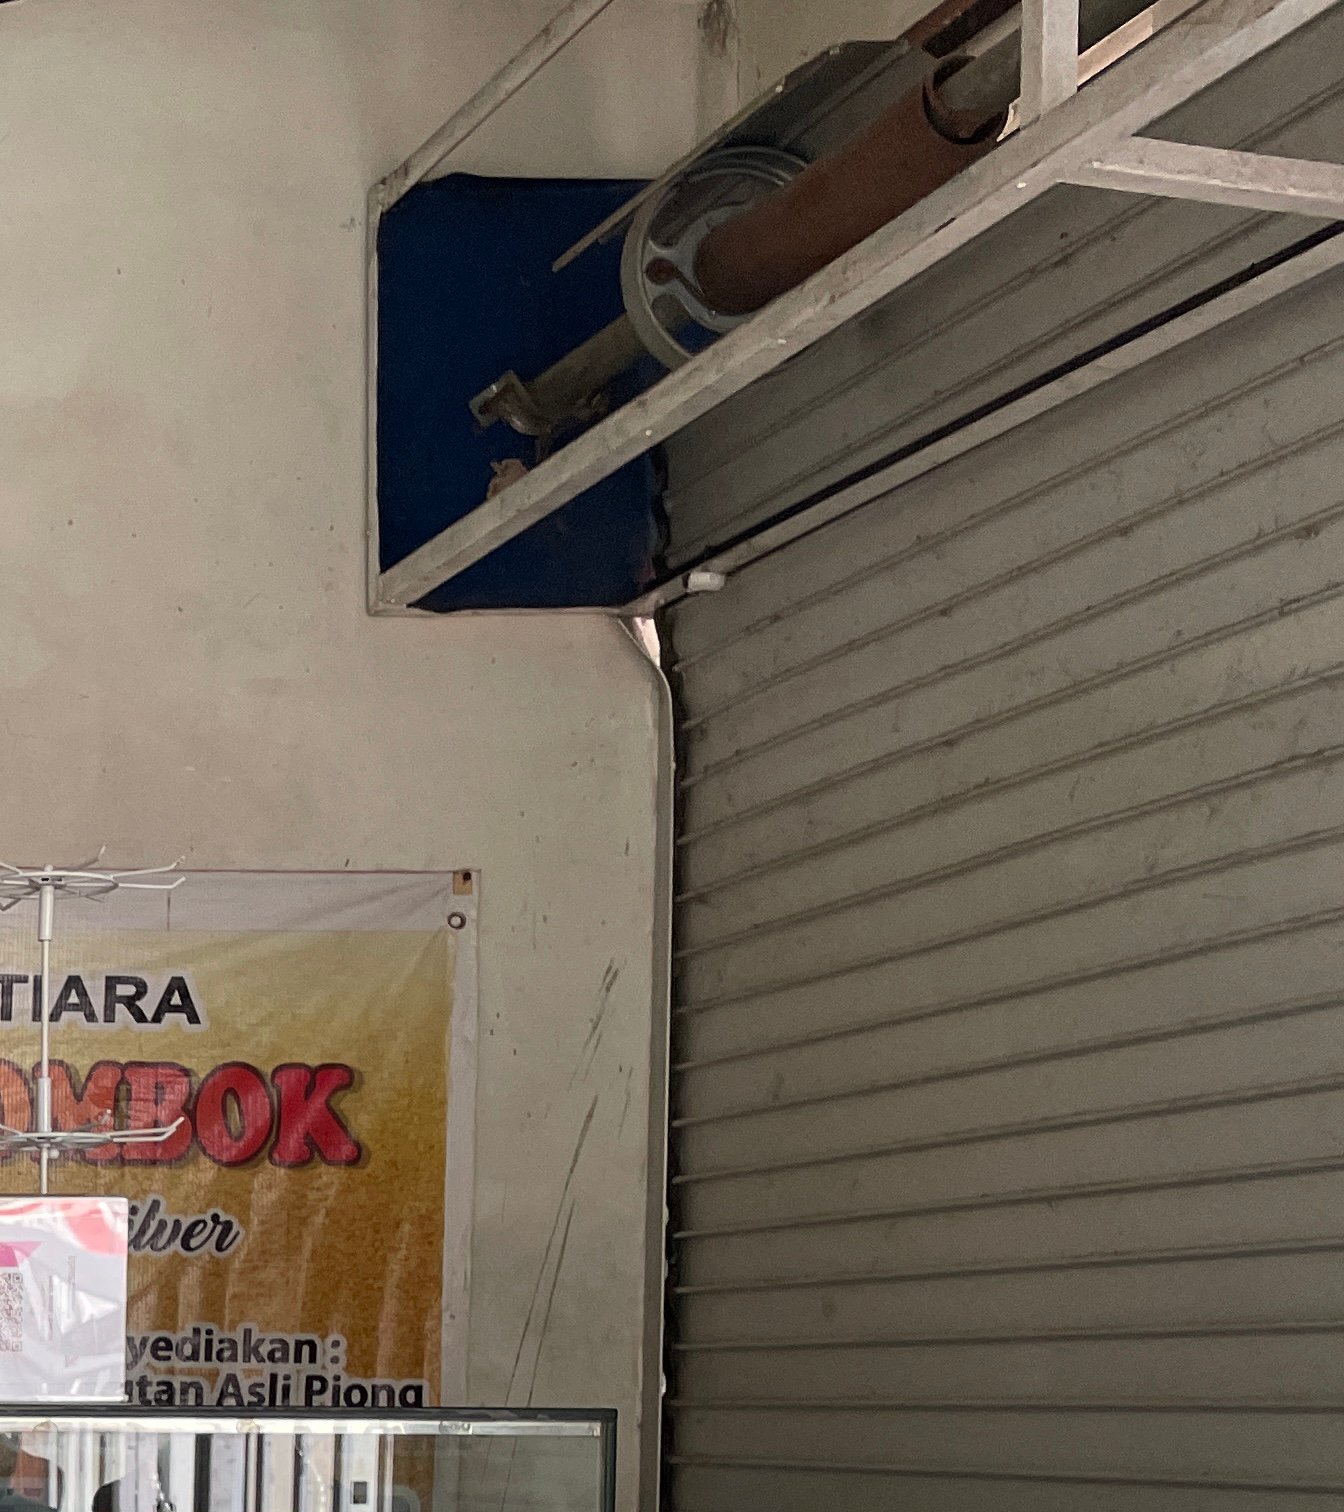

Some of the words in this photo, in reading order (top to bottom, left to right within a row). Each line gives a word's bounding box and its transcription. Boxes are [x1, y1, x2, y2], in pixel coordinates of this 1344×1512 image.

[127, 1198, 241, 1253] ilver
[126, 1327, 318, 1371] yediakan
[216, 1372, 291, 1407] Asli
[305, 1373, 425, 1407] Piong
